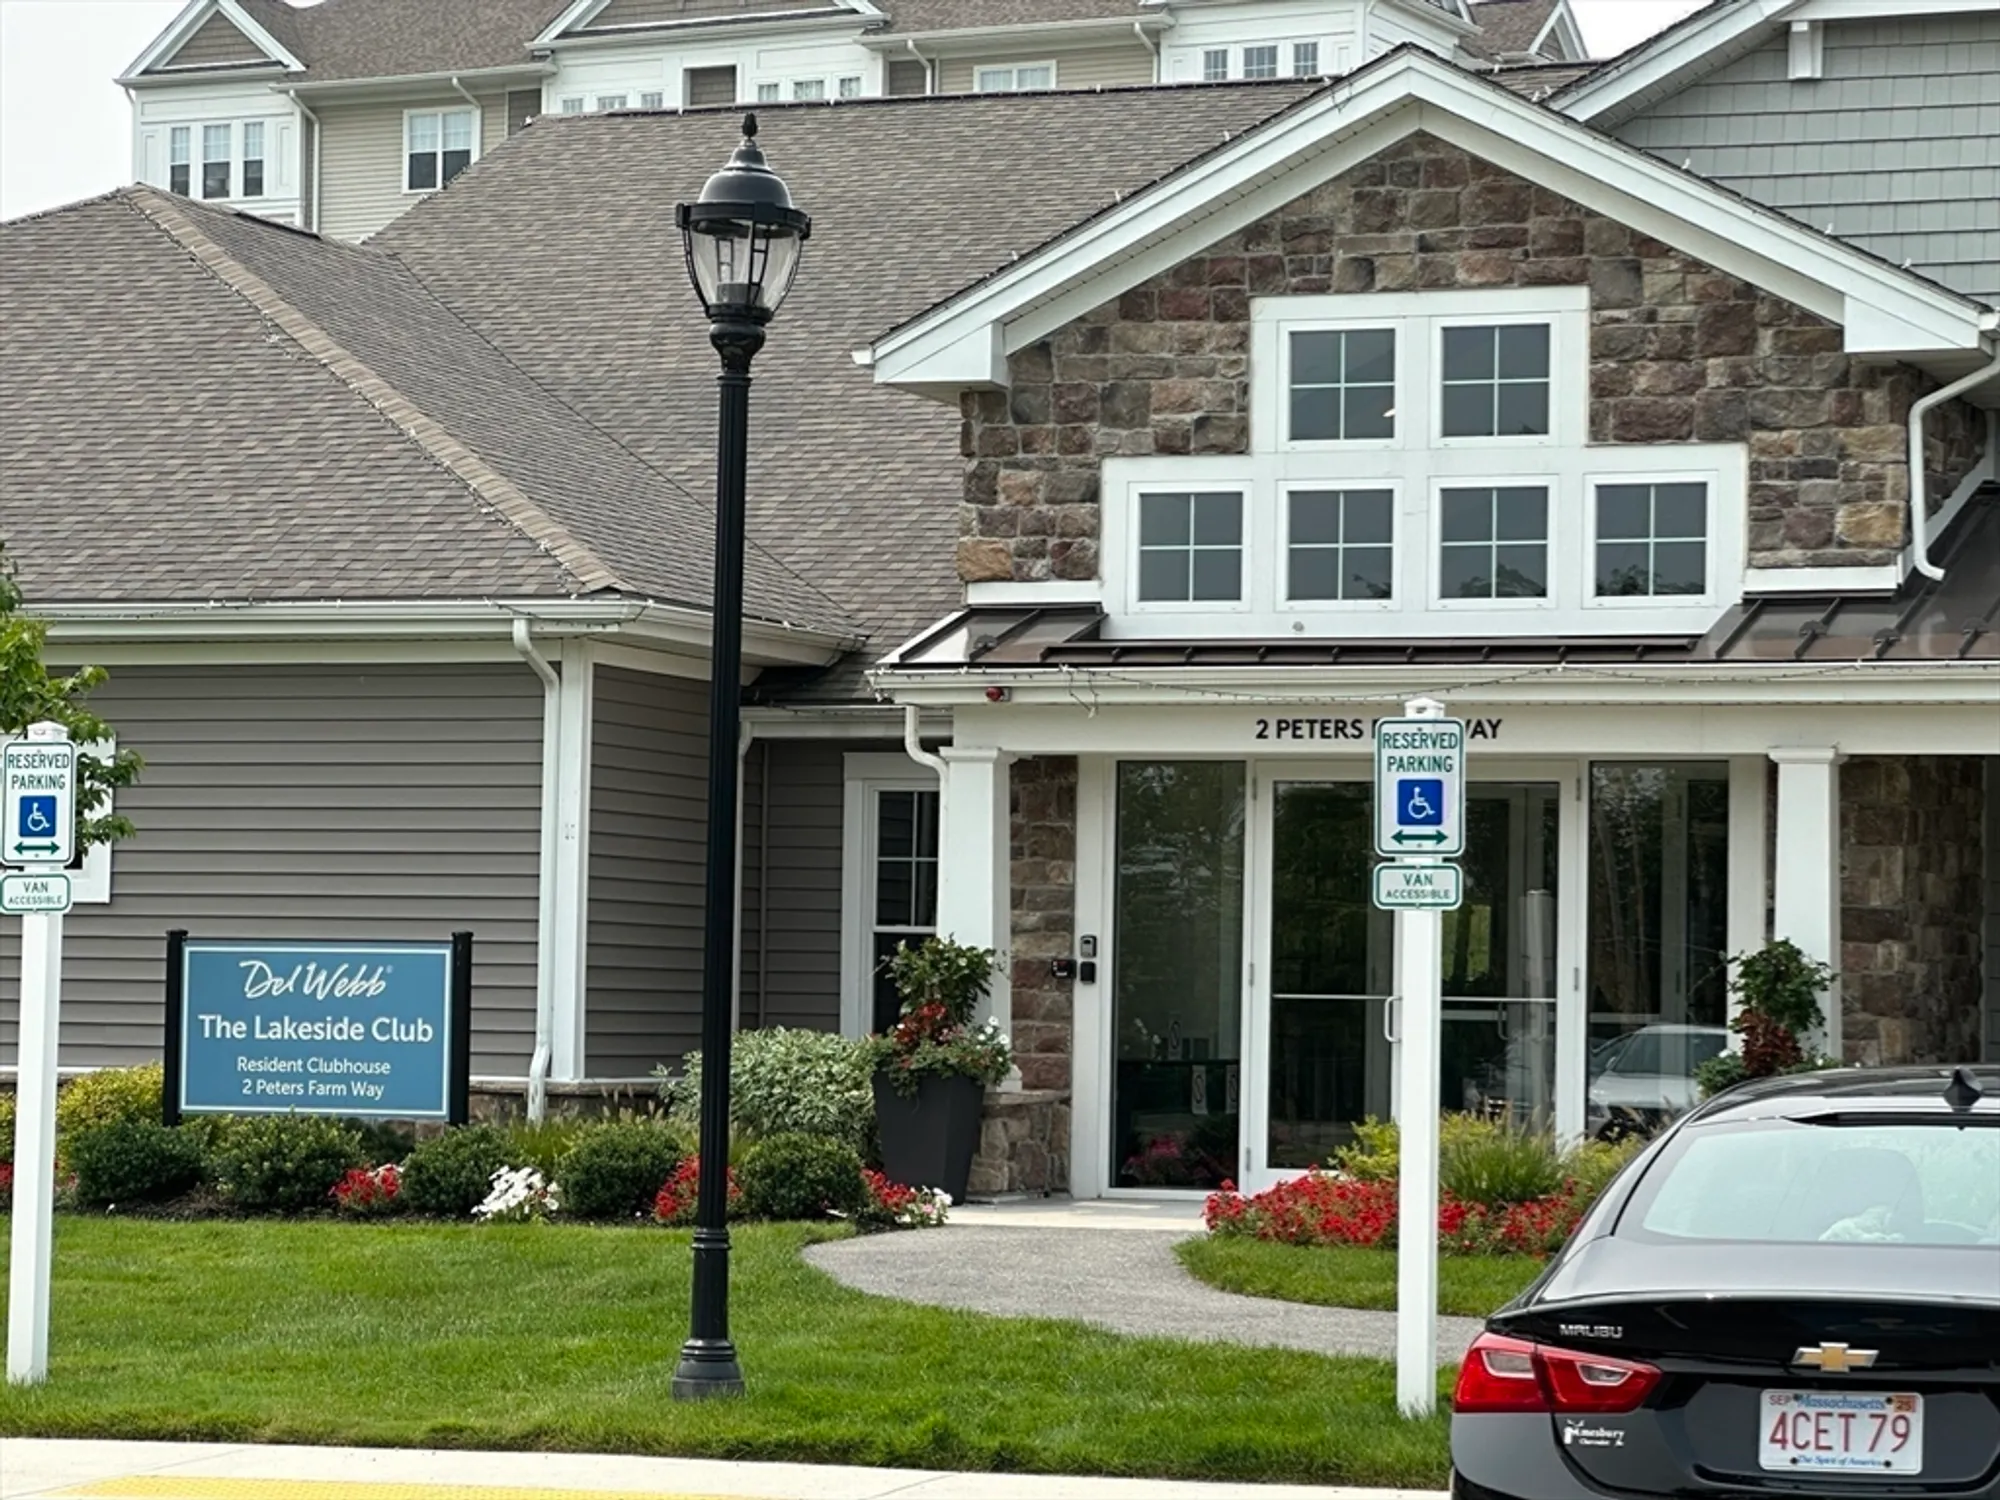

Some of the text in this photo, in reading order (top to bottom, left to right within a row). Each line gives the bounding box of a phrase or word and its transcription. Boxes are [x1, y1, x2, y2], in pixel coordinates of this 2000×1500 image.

[1256, 719, 1269, 739] 2
[1276, 719, 1364, 739] PETERS
[1464, 719, 1502, 738] AY
[1382, 732, 1459, 749] RESERVED
[8, 754, 70, 769] RESERVED
[1387, 756, 1454, 773] PARKING
[11, 774, 66, 790] PARKING
[24, 881, 49, 893] VAN
[1403, 873, 1434, 886] VAN
[8, 895, 63, 905] ACCESSIBLE
[1385, 889, 1450, 900] ACCESSIBLE
[239, 960, 387, 1000] Del Webb
[199, 1014, 433, 1042] The Lakeside Club
[237, 1056, 391, 1075] Resident Clubhouse
[242, 1078, 384, 1101] 2 Peters Farm Way
[1559, 1324, 1623, 1338] MALIBU
[1769, 1395, 1791, 1406] SEP
[1769, 1411, 1910, 1453] 4CET 79
